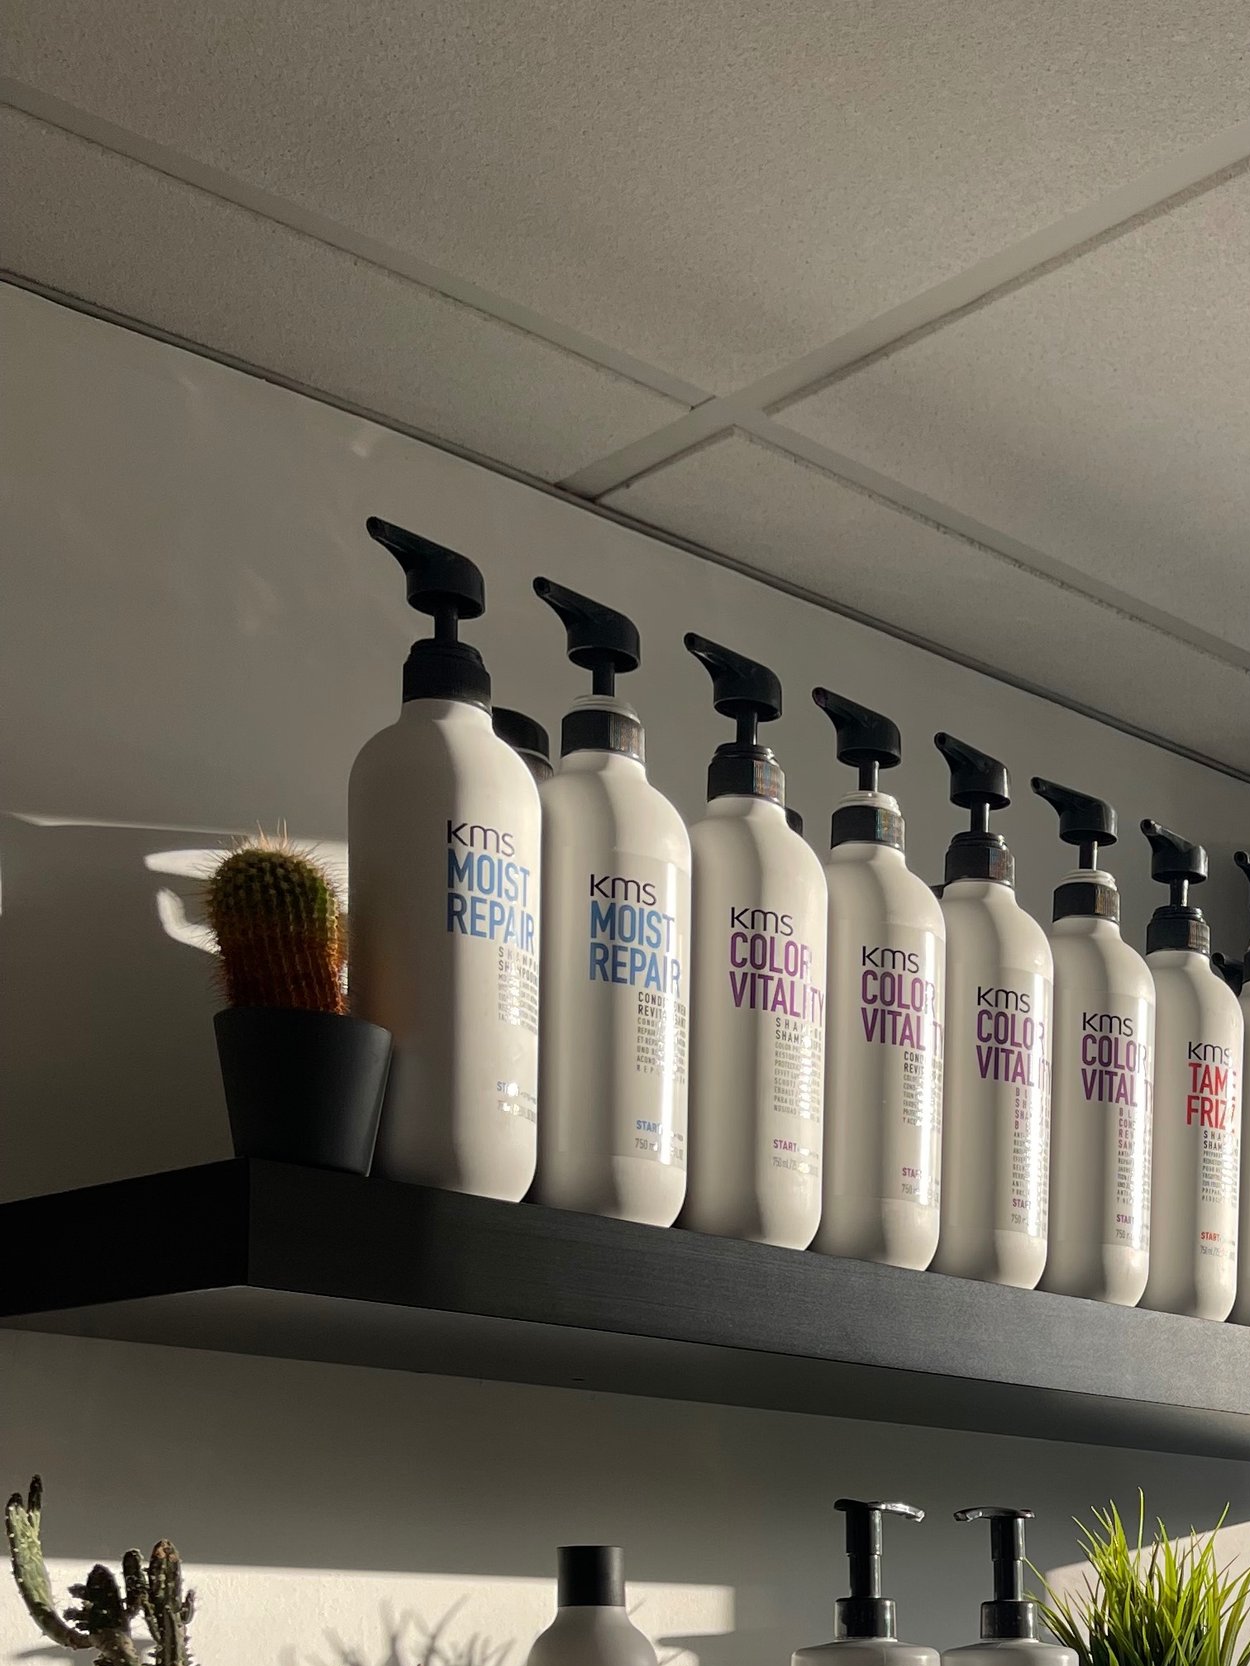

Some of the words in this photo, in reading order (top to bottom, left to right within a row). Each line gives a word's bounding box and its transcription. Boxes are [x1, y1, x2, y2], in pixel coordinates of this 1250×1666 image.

[447, 849, 530, 907] MOIST
[447, 892, 535, 956] REPAIR
[590, 900, 675, 953] MOIST
[589, 942, 680, 999] REPAIR
[730, 932, 812, 982] COLOR
